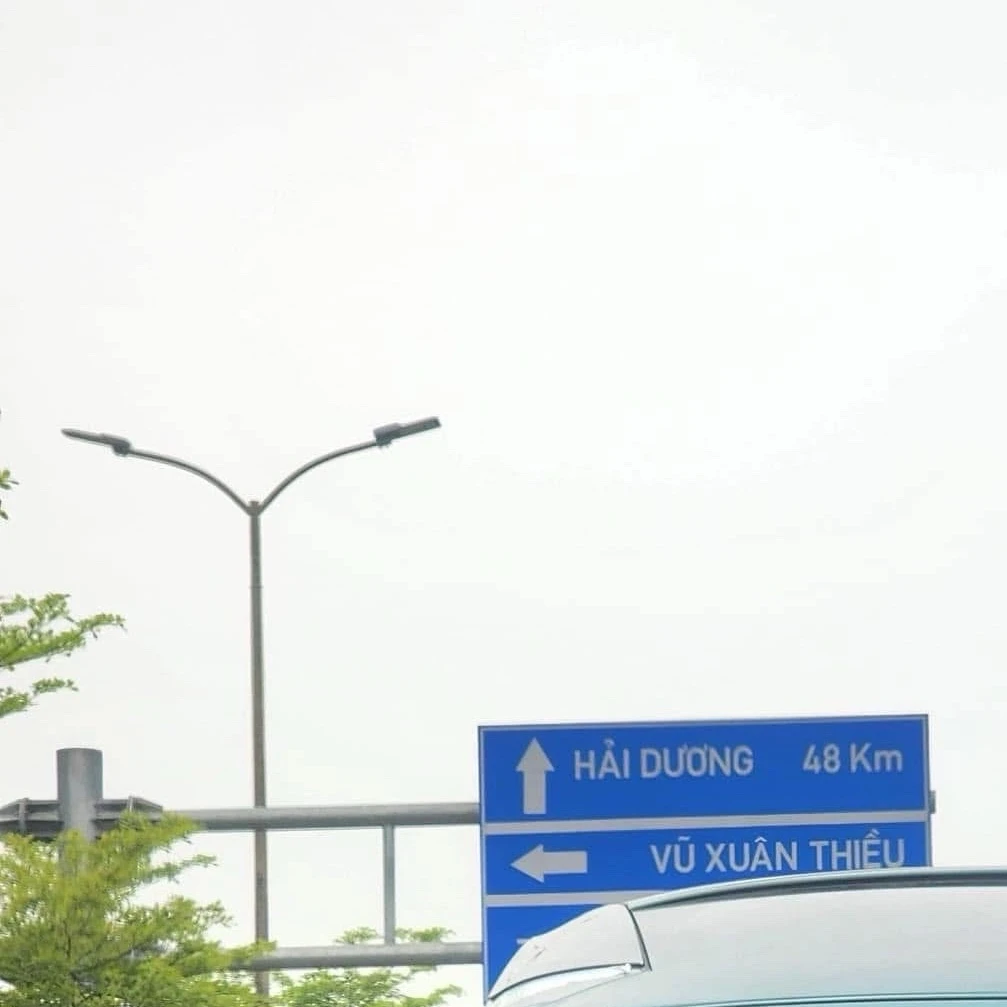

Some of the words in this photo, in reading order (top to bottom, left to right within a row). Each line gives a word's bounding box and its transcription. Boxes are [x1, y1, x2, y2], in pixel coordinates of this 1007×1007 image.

[574, 738, 630, 780] HẢI
[640, 743, 754, 778] DƯƠNG
[803, 743, 841, 773] 48
[850, 742, 903, 773] Km
[650, 835, 697, 874] VŨ
[706, 835, 799, 872] XUÂN
[808, 828, 905, 869] THIỀU
